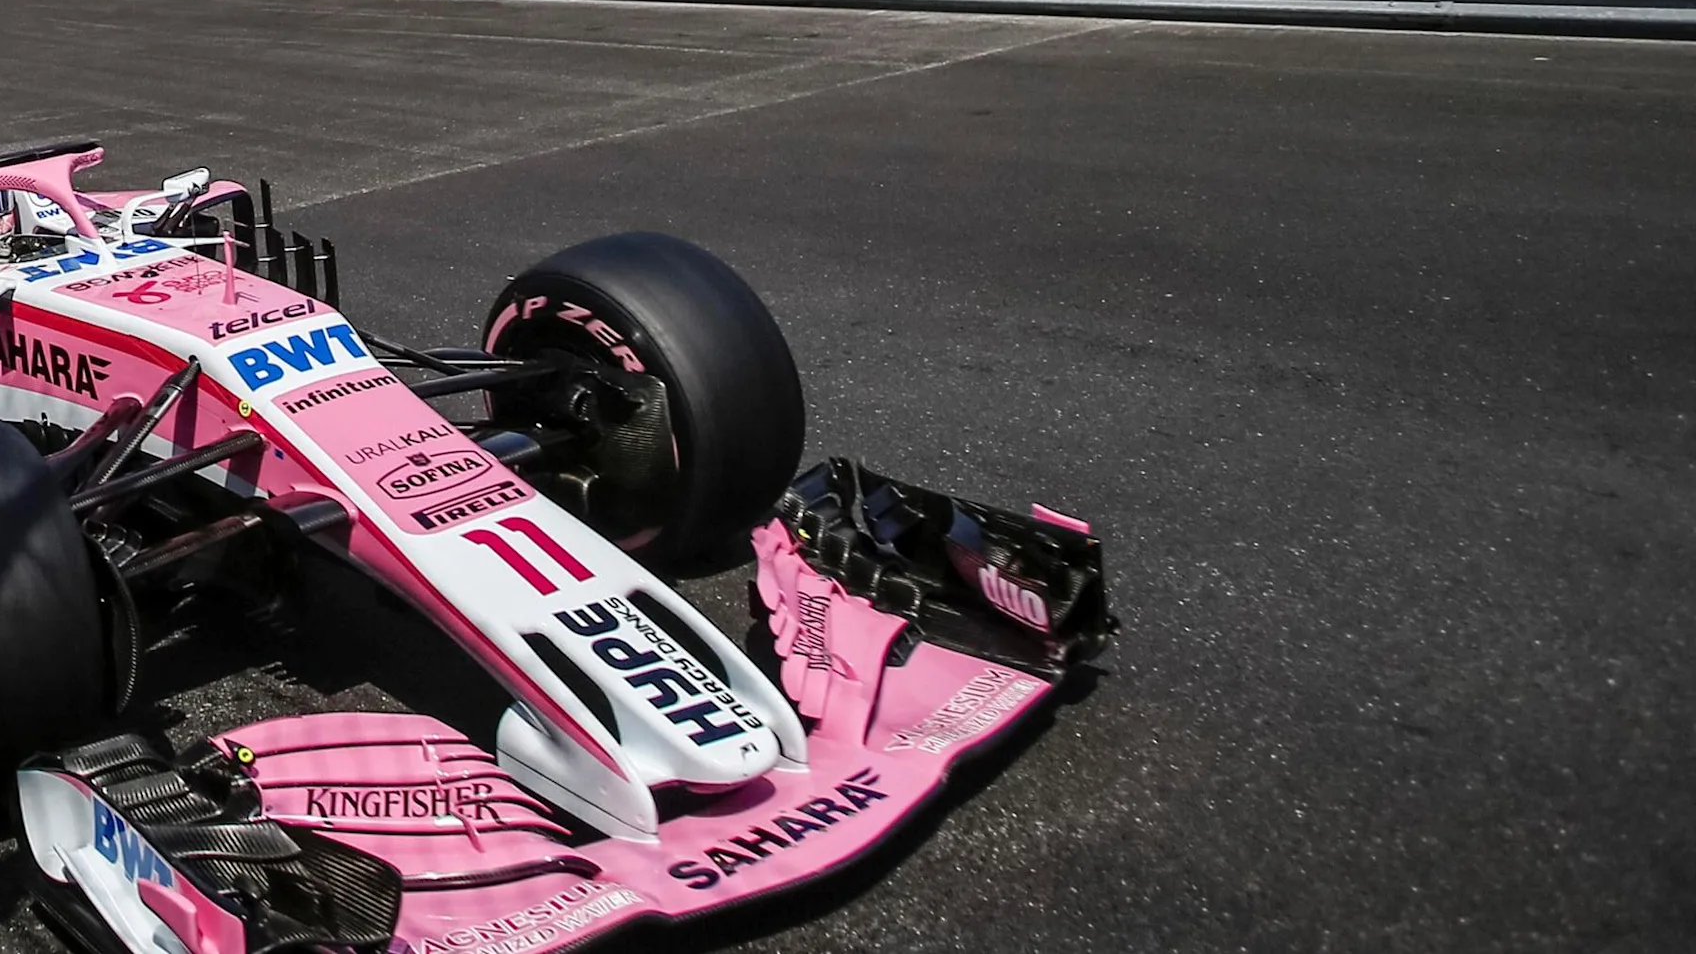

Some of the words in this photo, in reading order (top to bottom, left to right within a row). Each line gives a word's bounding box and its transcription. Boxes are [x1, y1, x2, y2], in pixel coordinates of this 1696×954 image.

[209, 299, 315, 340] telcel
[228, 323, 368, 392] BWT
[282, 373, 398, 414] infinitum
[345, 424, 454, 465] URALKALI
[390, 457, 484, 495] SOFINA
[410, 480, 527, 530] PIRELLI
[459, 516, 596, 597] 11
[604, 595, 678, 656] DRINKS
[553, 602, 747, 747] HYPE
[306, 783, 506, 825] KINGFISHER
[667, 766, 889, 890] SAHARA
[93, 795, 176, 889] BWT
